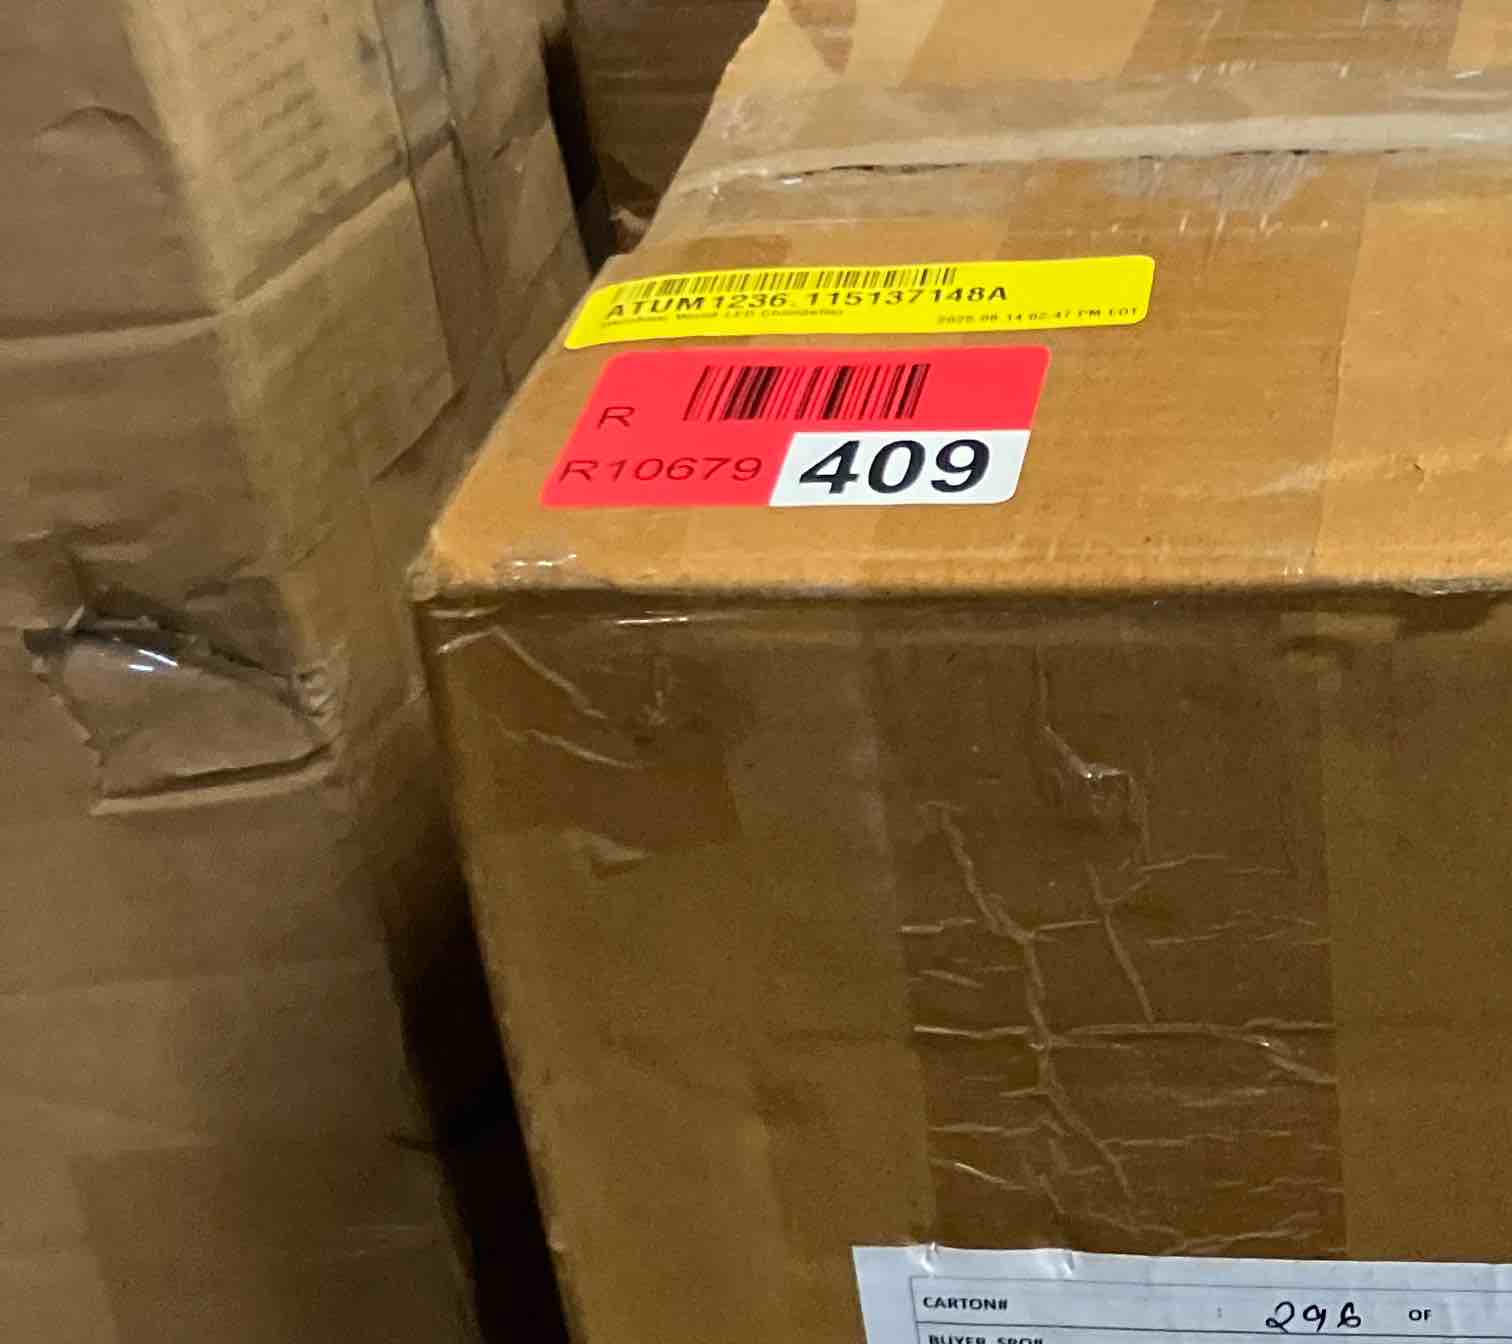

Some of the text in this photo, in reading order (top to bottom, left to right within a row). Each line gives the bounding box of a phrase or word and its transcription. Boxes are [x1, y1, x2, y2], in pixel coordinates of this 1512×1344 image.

[599, 406, 635, 430] R
[559, 439, 990, 495] R10679 409
[923, 1296, 1008, 1311] CARTON#
[1265, 1301, 1362, 1333] 296
[1408, 1308, 1432, 1322] OF
